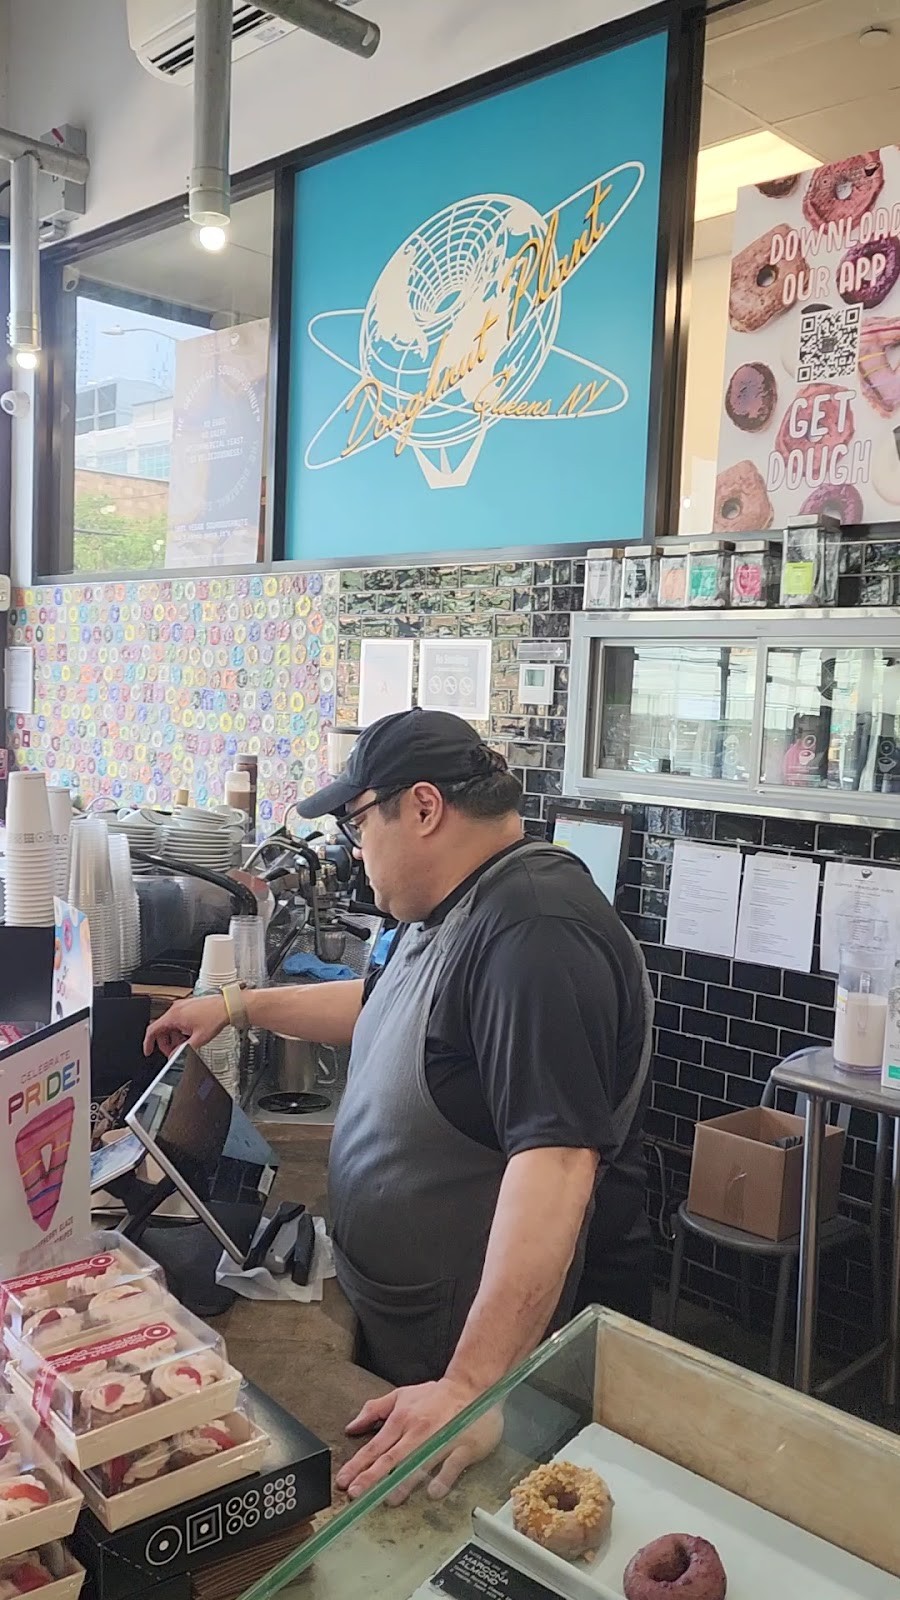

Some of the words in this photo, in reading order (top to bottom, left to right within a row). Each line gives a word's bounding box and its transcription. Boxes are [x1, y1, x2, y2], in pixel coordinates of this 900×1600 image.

[782, 266, 830, 305] OUR
[839, 253, 886, 293] APP
[341, 307, 500, 457] Doughnut
[501, 181, 612, 340] Plant
[473, 370, 551, 424] Queens
[556, 379, 610, 418] NY
[789, 390, 856, 439] GET
[767, 439, 872, 492] DOUGH
[8, 1059, 80, 1125] PRIDE!
[20, 1049, 70, 1085] CELEBRATE
[458, 1560, 498, 1585] ALMOND
[463, 1554, 508, 1585] MARCONA
